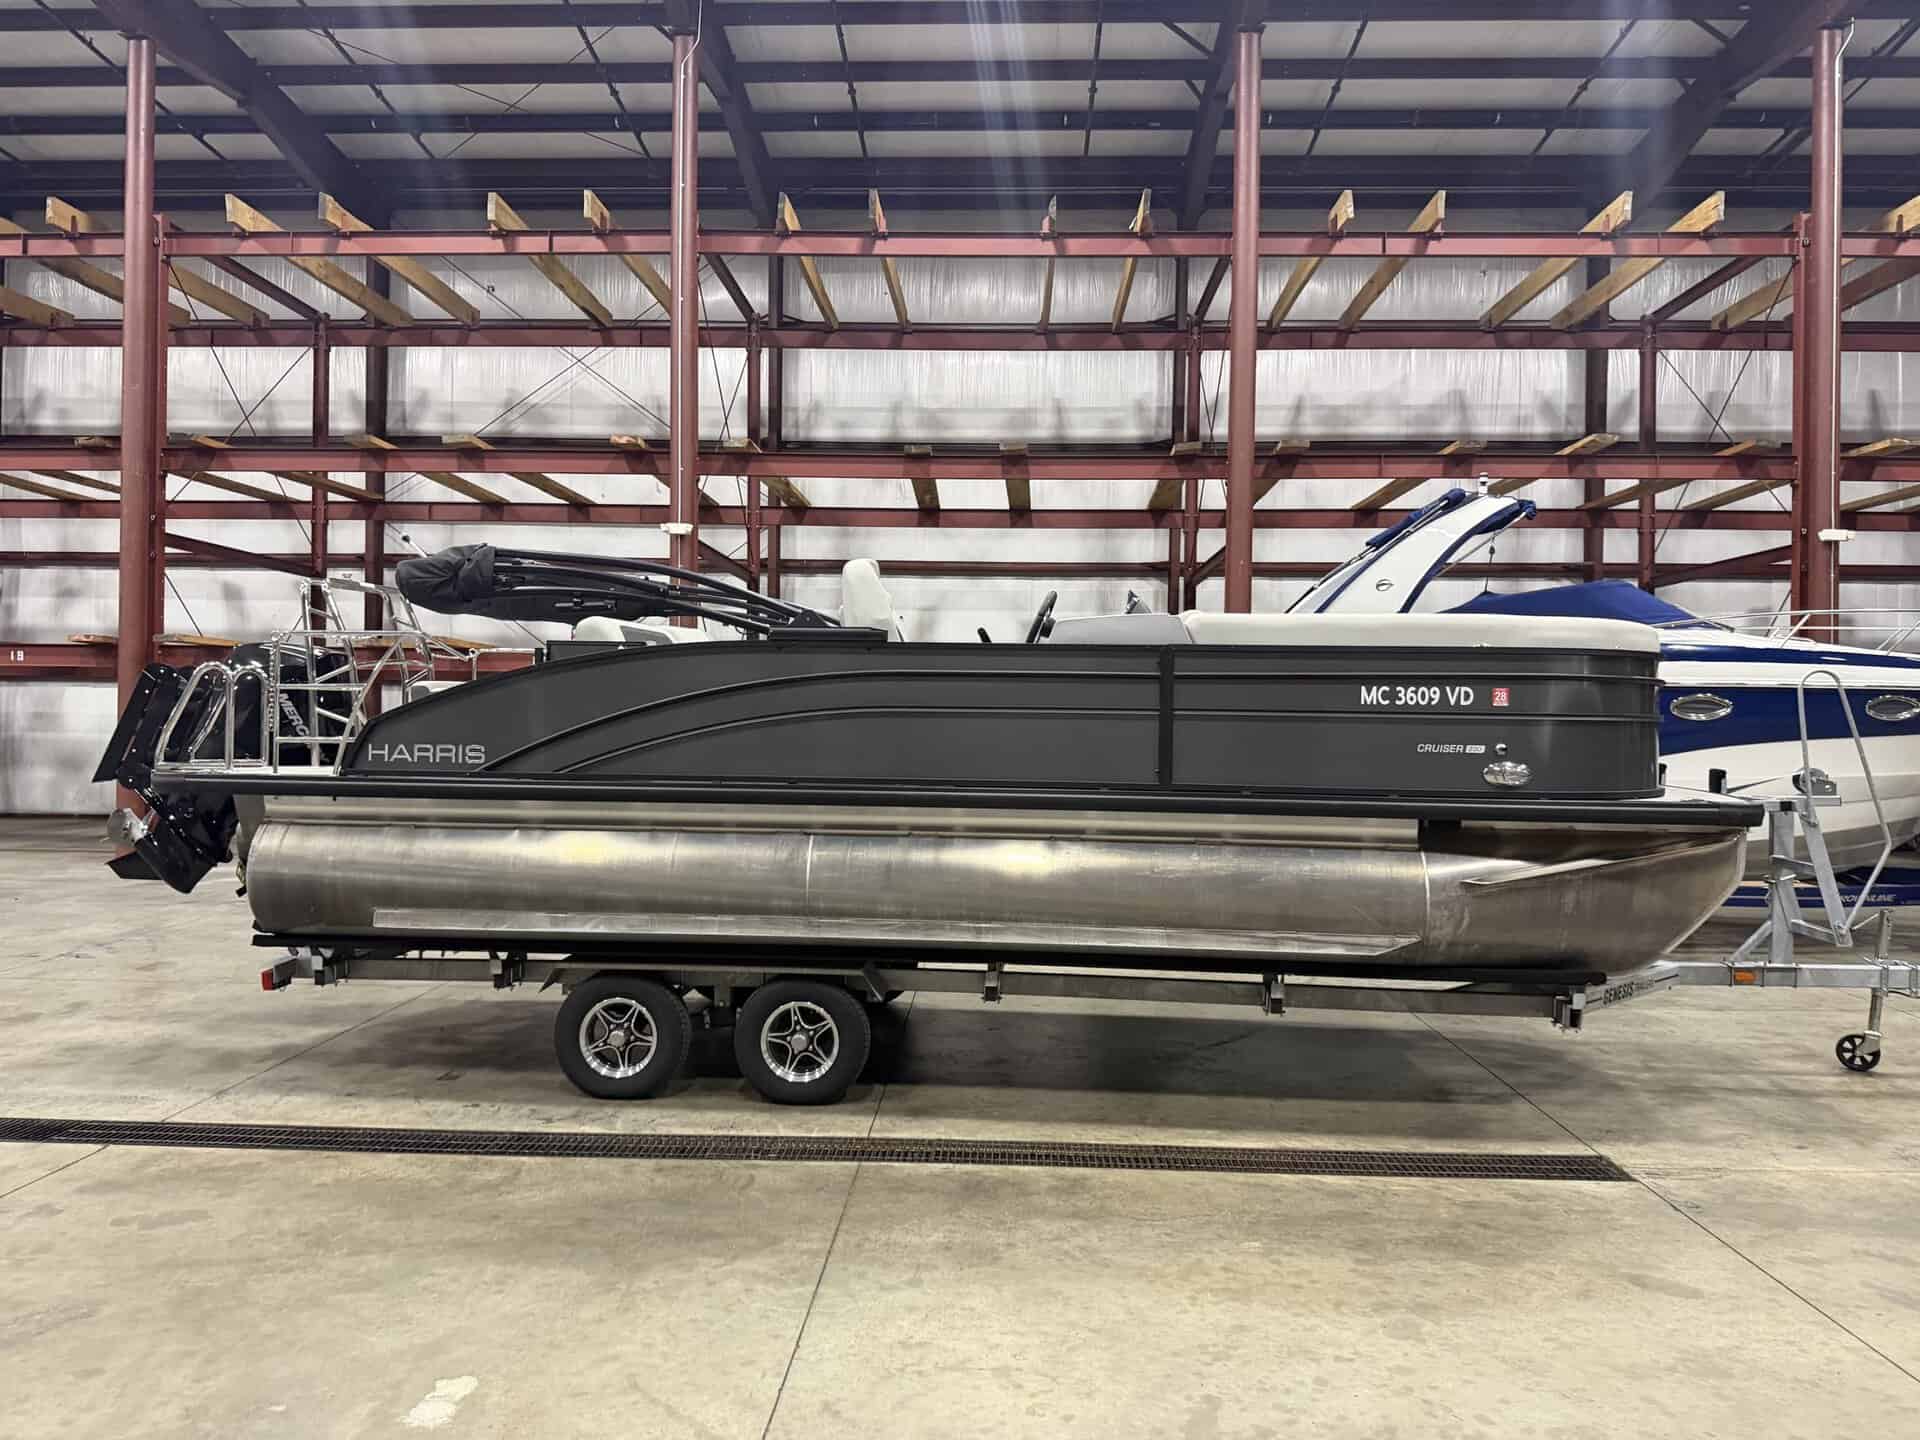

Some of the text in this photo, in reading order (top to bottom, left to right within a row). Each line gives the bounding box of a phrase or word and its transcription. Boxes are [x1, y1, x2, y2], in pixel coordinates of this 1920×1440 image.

[1360, 686, 1474, 706] MC 3609 VD
[368, 743, 486, 764] HARRIS
[1416, 744, 1464, 753] CRUISER
